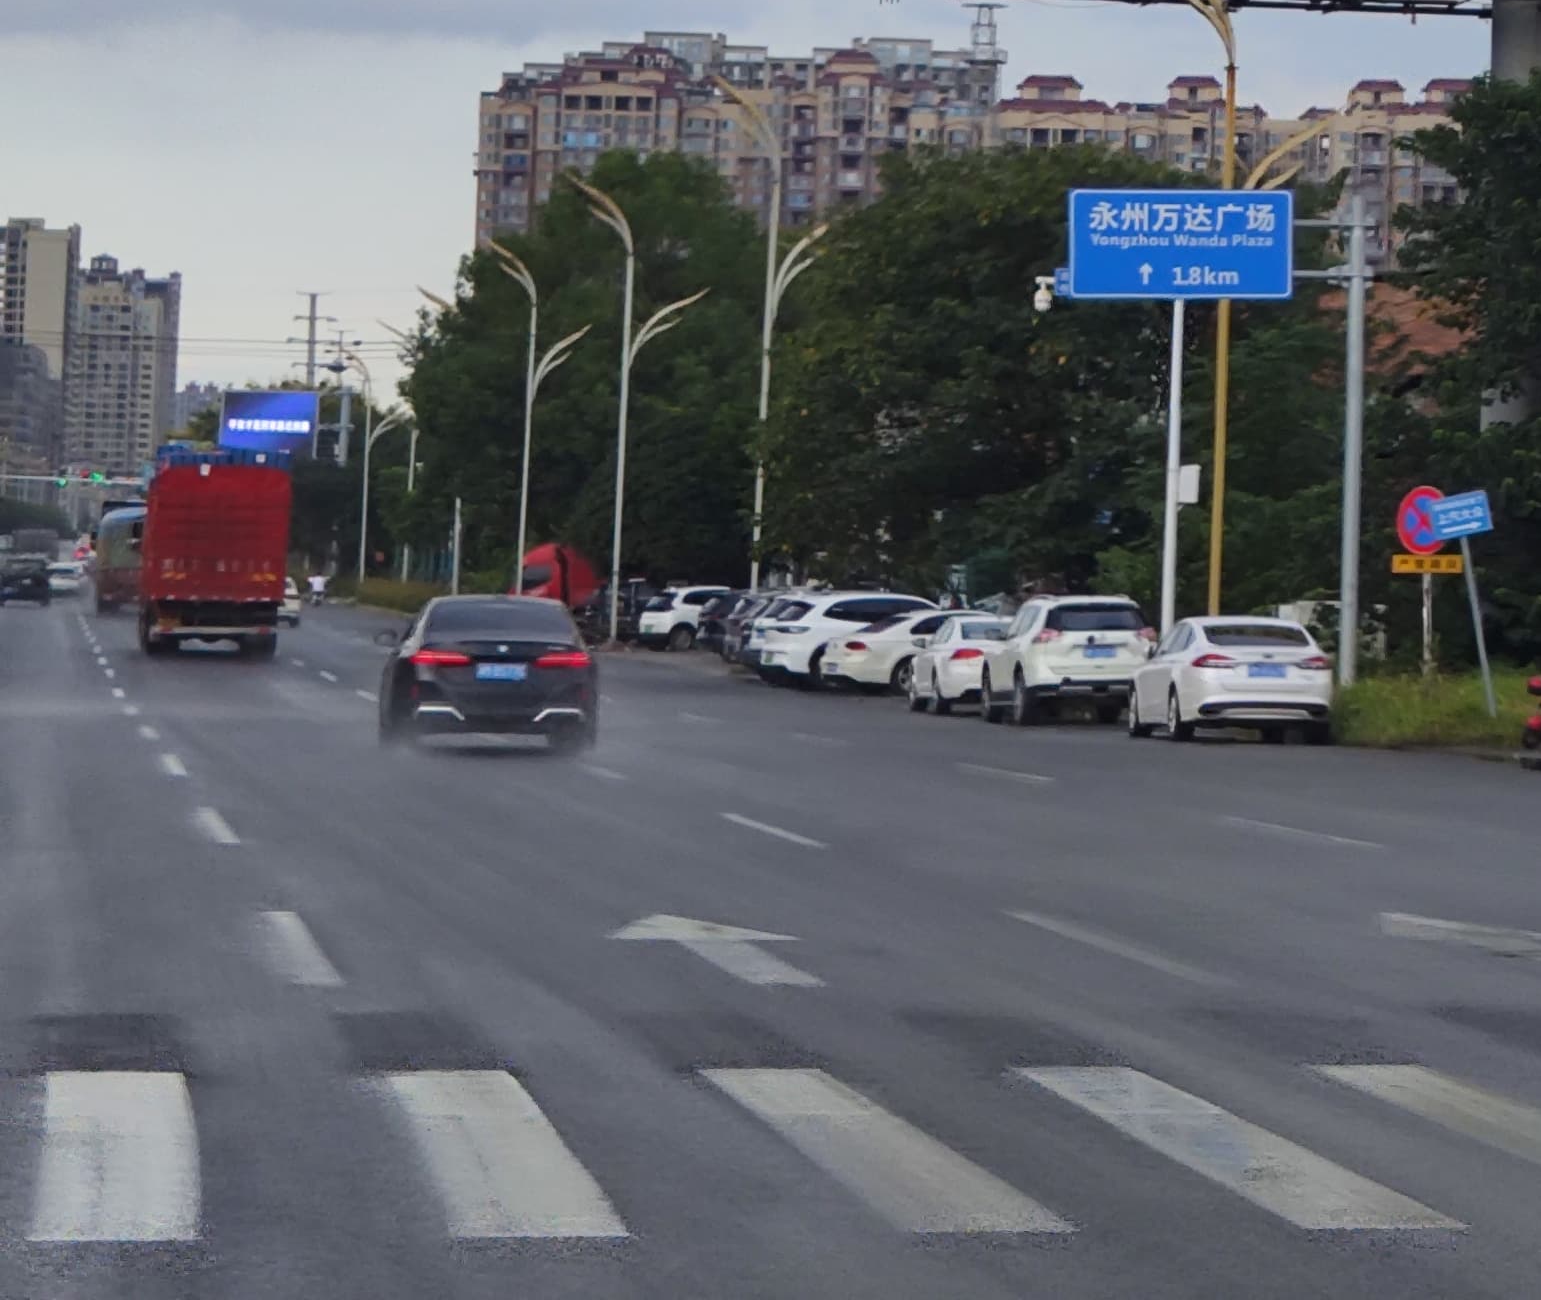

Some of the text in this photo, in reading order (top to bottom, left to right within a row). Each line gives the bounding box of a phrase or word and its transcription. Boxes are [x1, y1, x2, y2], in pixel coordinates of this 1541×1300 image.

[1088, 201, 1276, 233] 永州万达广场
[1090, 233, 1274, 250] Yongzhou Wanda Plaza
